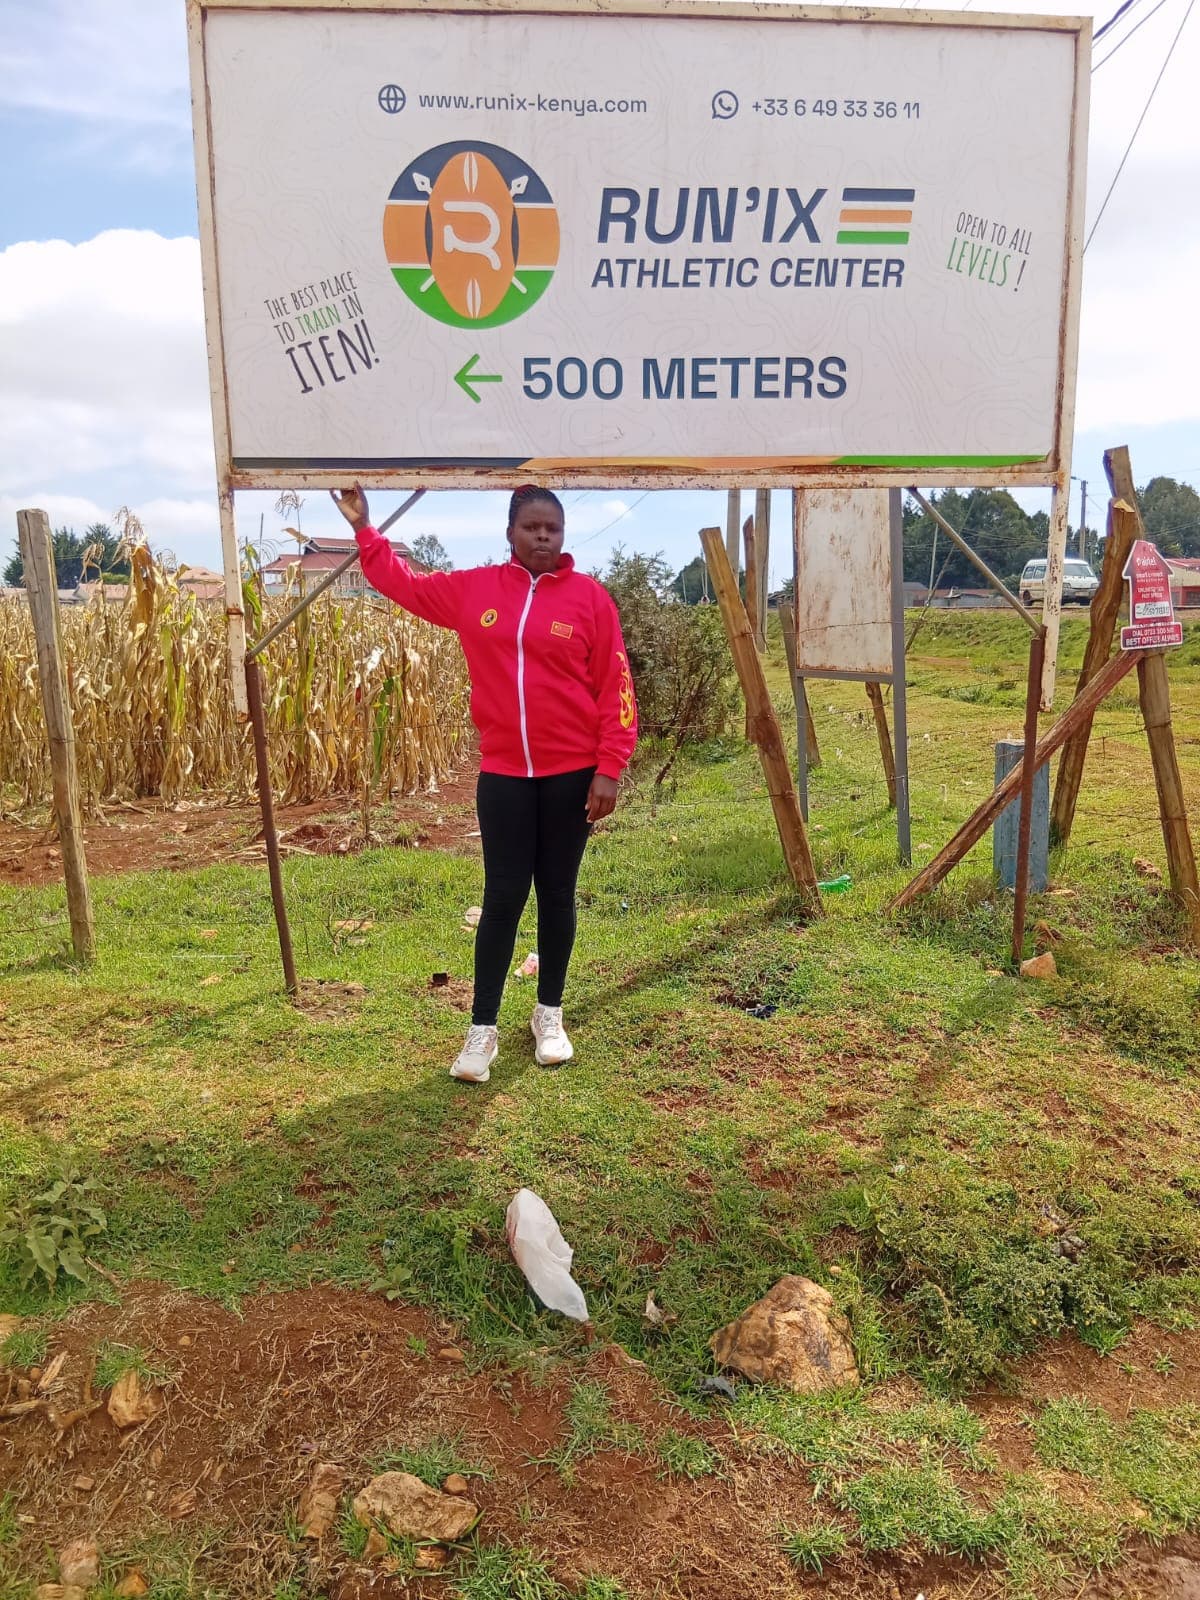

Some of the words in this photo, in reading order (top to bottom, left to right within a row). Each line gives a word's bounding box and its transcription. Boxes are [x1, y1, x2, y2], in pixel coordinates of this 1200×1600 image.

[418, 93, 648, 117] www.runix-kenya.com
[752, 98, 788, 116] +33
[794, 99, 806, 117] 6
[812, 99, 838, 117] 49
[843, 100, 868, 118] 33
[873, 101, 897, 119] 36
[903, 102, 920, 119] 11
[956, 211, 988, 241] OPEN
[991, 222, 1007, 246] TO
[1008, 228, 1032, 255] ALL
[590, 257, 760, 289] ATHLETIC
[769, 257, 906, 289] CENTER
[947, 237, 1012, 287] LEVELS
[263, 296, 291, 320] THE
[290, 285, 320, 312] BEST
[320, 271, 358, 300] PLACE
[273, 321, 296, 345] TO
[295, 303, 342, 336] TRAIN
[342, 291, 364, 319] IN
[285, 318, 380, 394] ITEN!
[522, 356, 624, 401] 500
[642, 355, 848, 400] METERS
